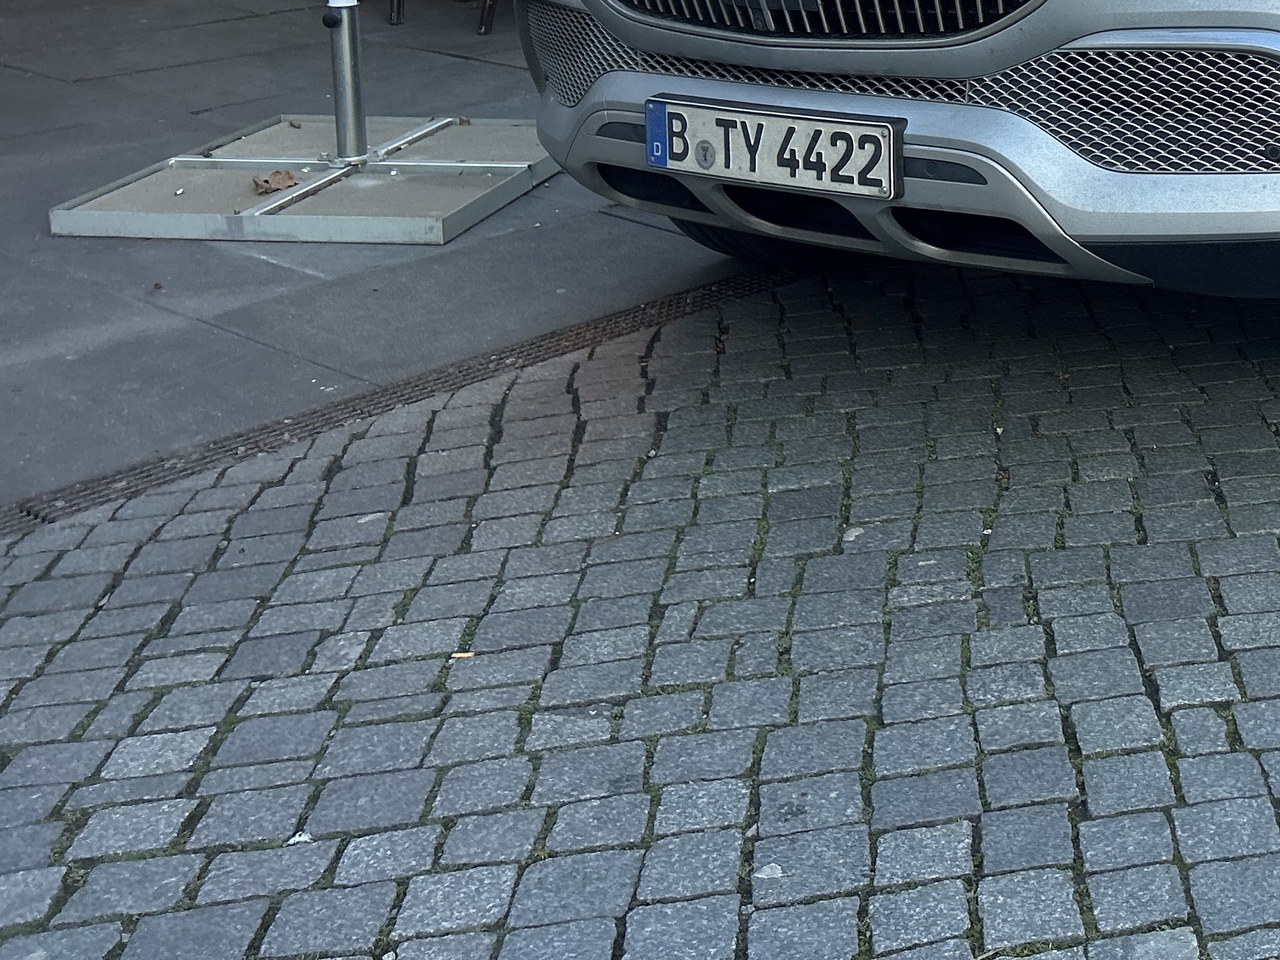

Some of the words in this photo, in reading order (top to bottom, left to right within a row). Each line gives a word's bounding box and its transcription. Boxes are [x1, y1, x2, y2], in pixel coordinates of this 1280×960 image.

[653, 142, 662, 157] D
[667, 111, 690, 162] B
[715, 117, 764, 173] TY
[776, 126, 884, 188] 4422
